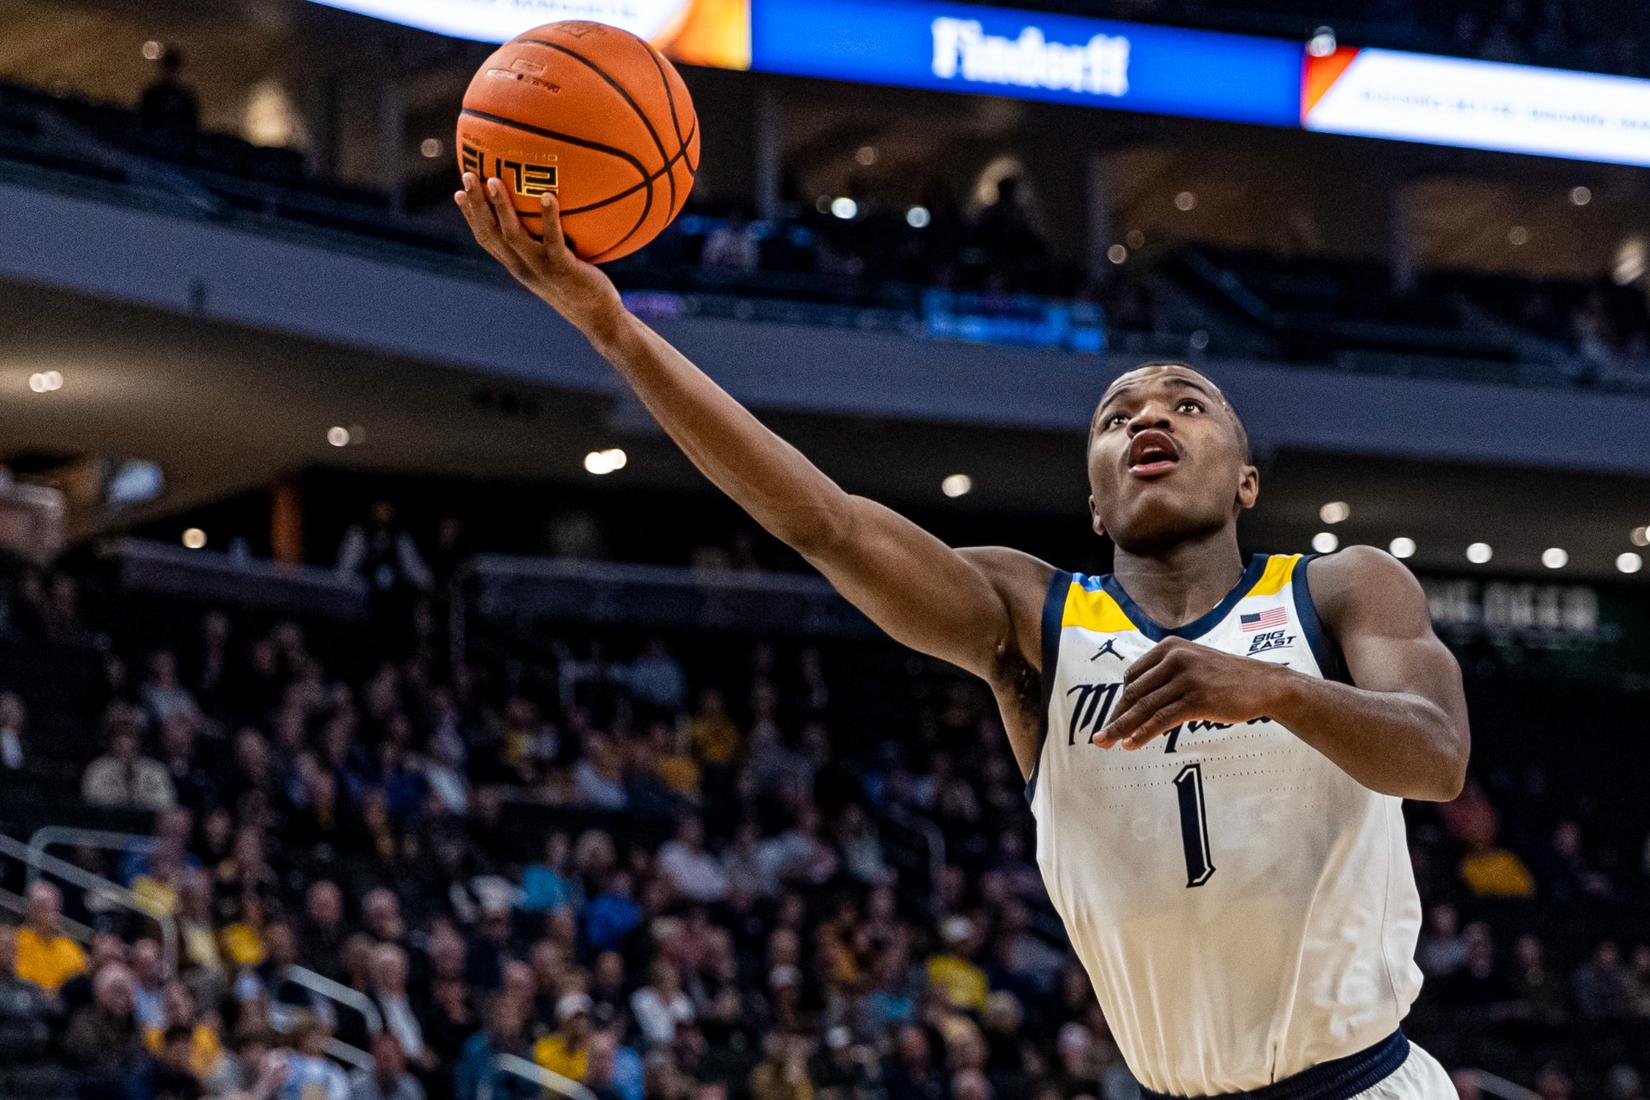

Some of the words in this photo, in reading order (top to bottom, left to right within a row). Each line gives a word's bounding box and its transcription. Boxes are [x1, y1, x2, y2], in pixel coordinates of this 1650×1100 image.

[1249, 636, 1297, 652] EAST
[1252, 630, 1286, 644] BIG
[1172, 763, 1216, 888] 1
